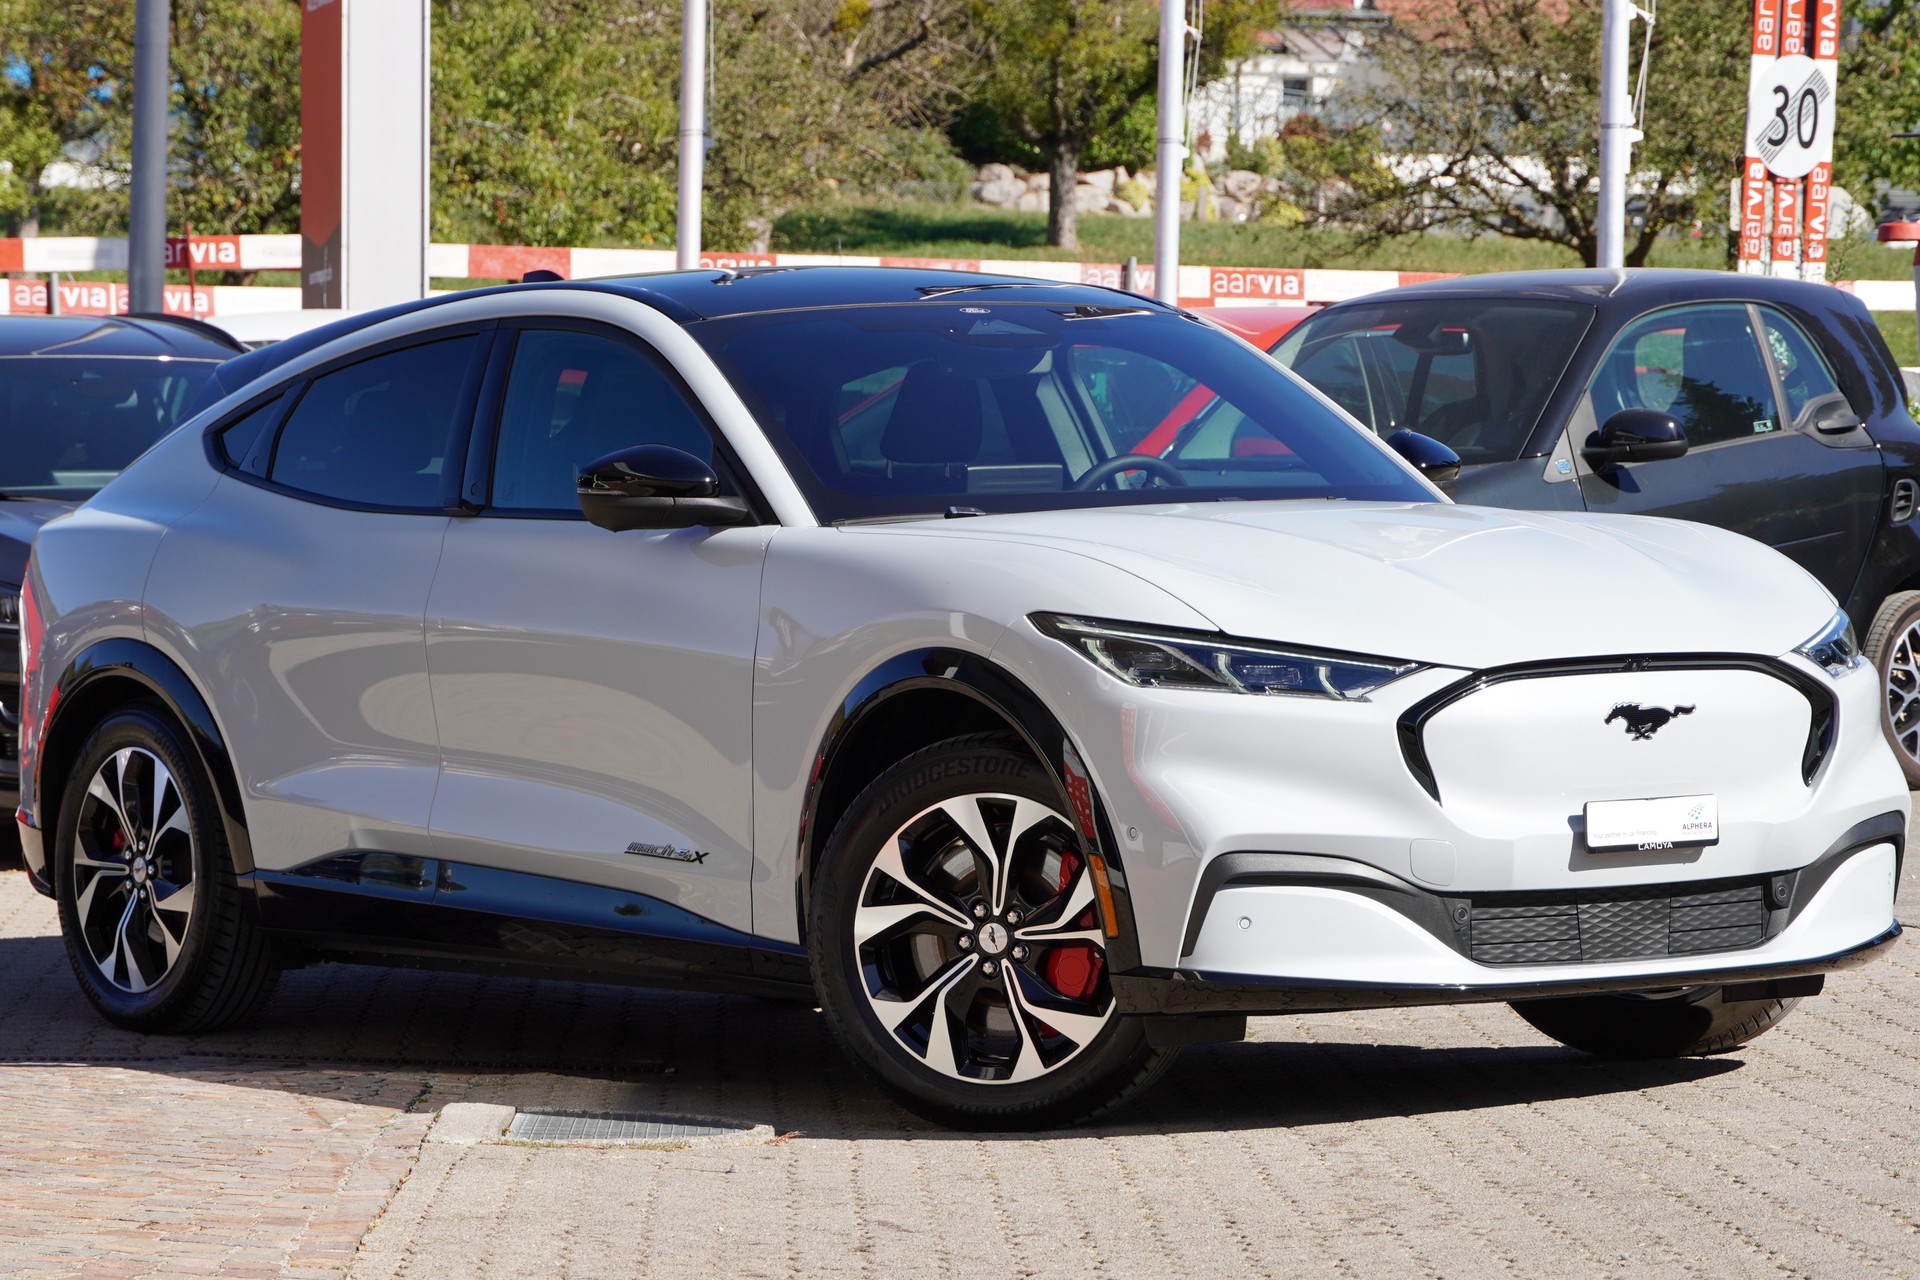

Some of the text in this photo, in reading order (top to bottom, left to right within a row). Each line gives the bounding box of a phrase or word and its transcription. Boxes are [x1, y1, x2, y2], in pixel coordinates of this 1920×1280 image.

[1767, 85, 1818, 149] 30
[1745, 162, 1765, 255] aarvia
[1776, 183, 1795, 257] aarvi
[1808, 166, 1828, 259] aarvia
[14, 284, 108, 308] aavia
[1213, 272, 1299, 295] aarvia
[1638, 841, 1674, 851] CAMOYA
[1682, 821, 1713, 831] ALPHERA
